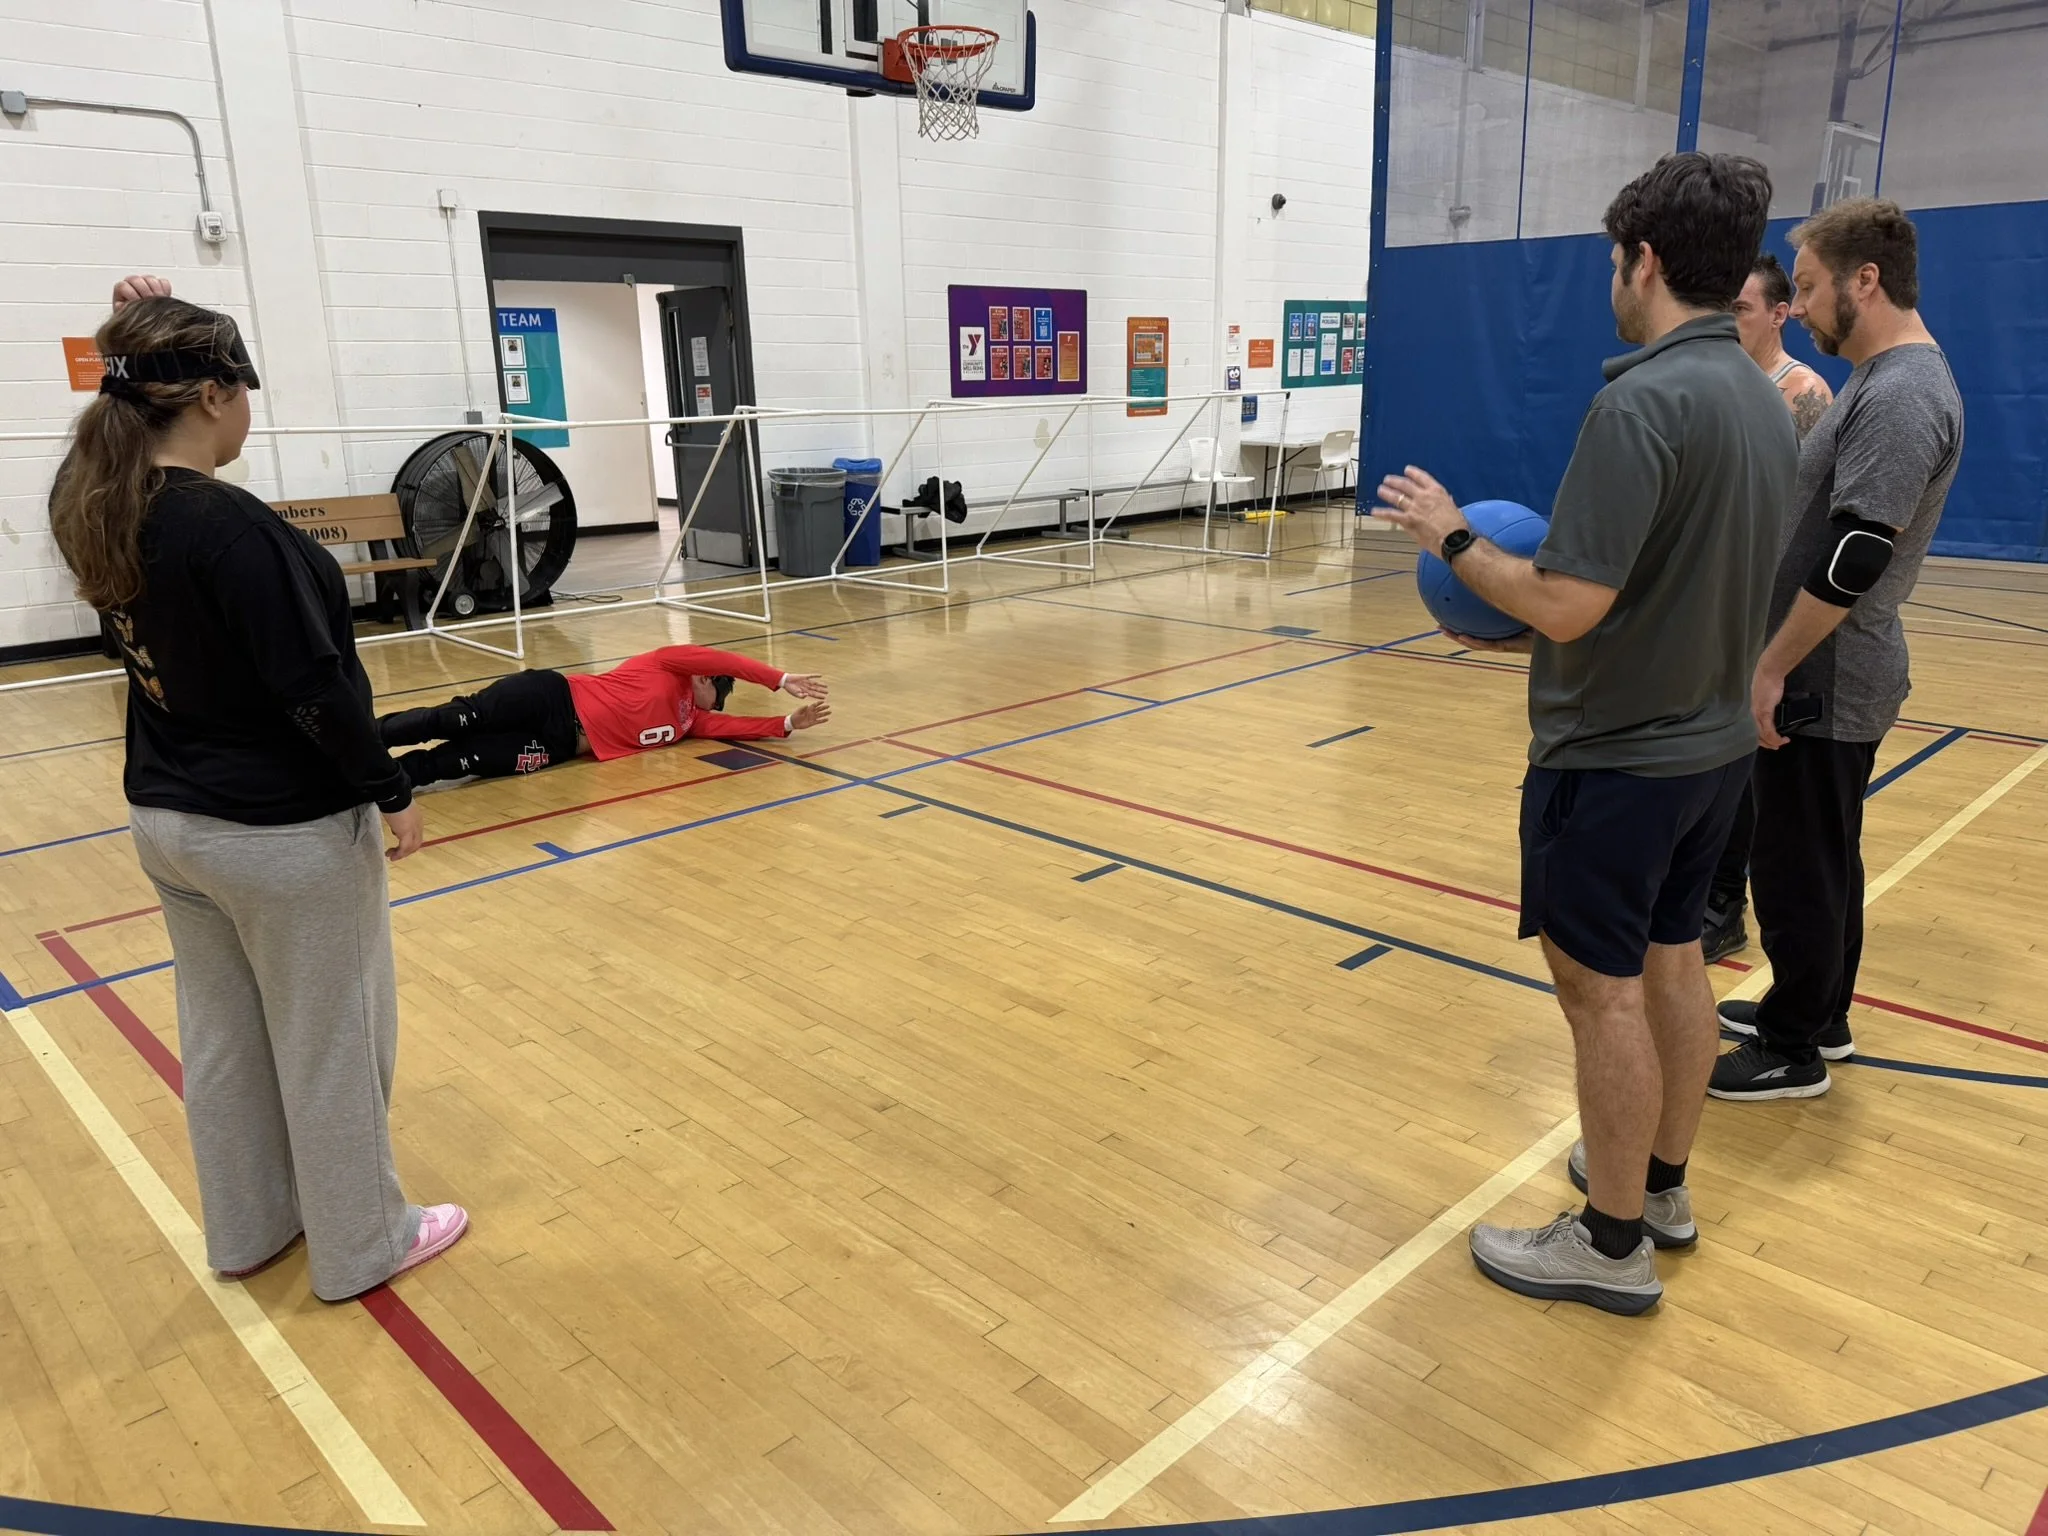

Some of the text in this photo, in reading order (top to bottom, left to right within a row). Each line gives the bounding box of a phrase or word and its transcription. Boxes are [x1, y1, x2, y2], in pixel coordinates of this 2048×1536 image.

[499, 313, 541, 327] TEAM
[968, 334, 982, 356] Y
[639, 724, 675, 746] 6
